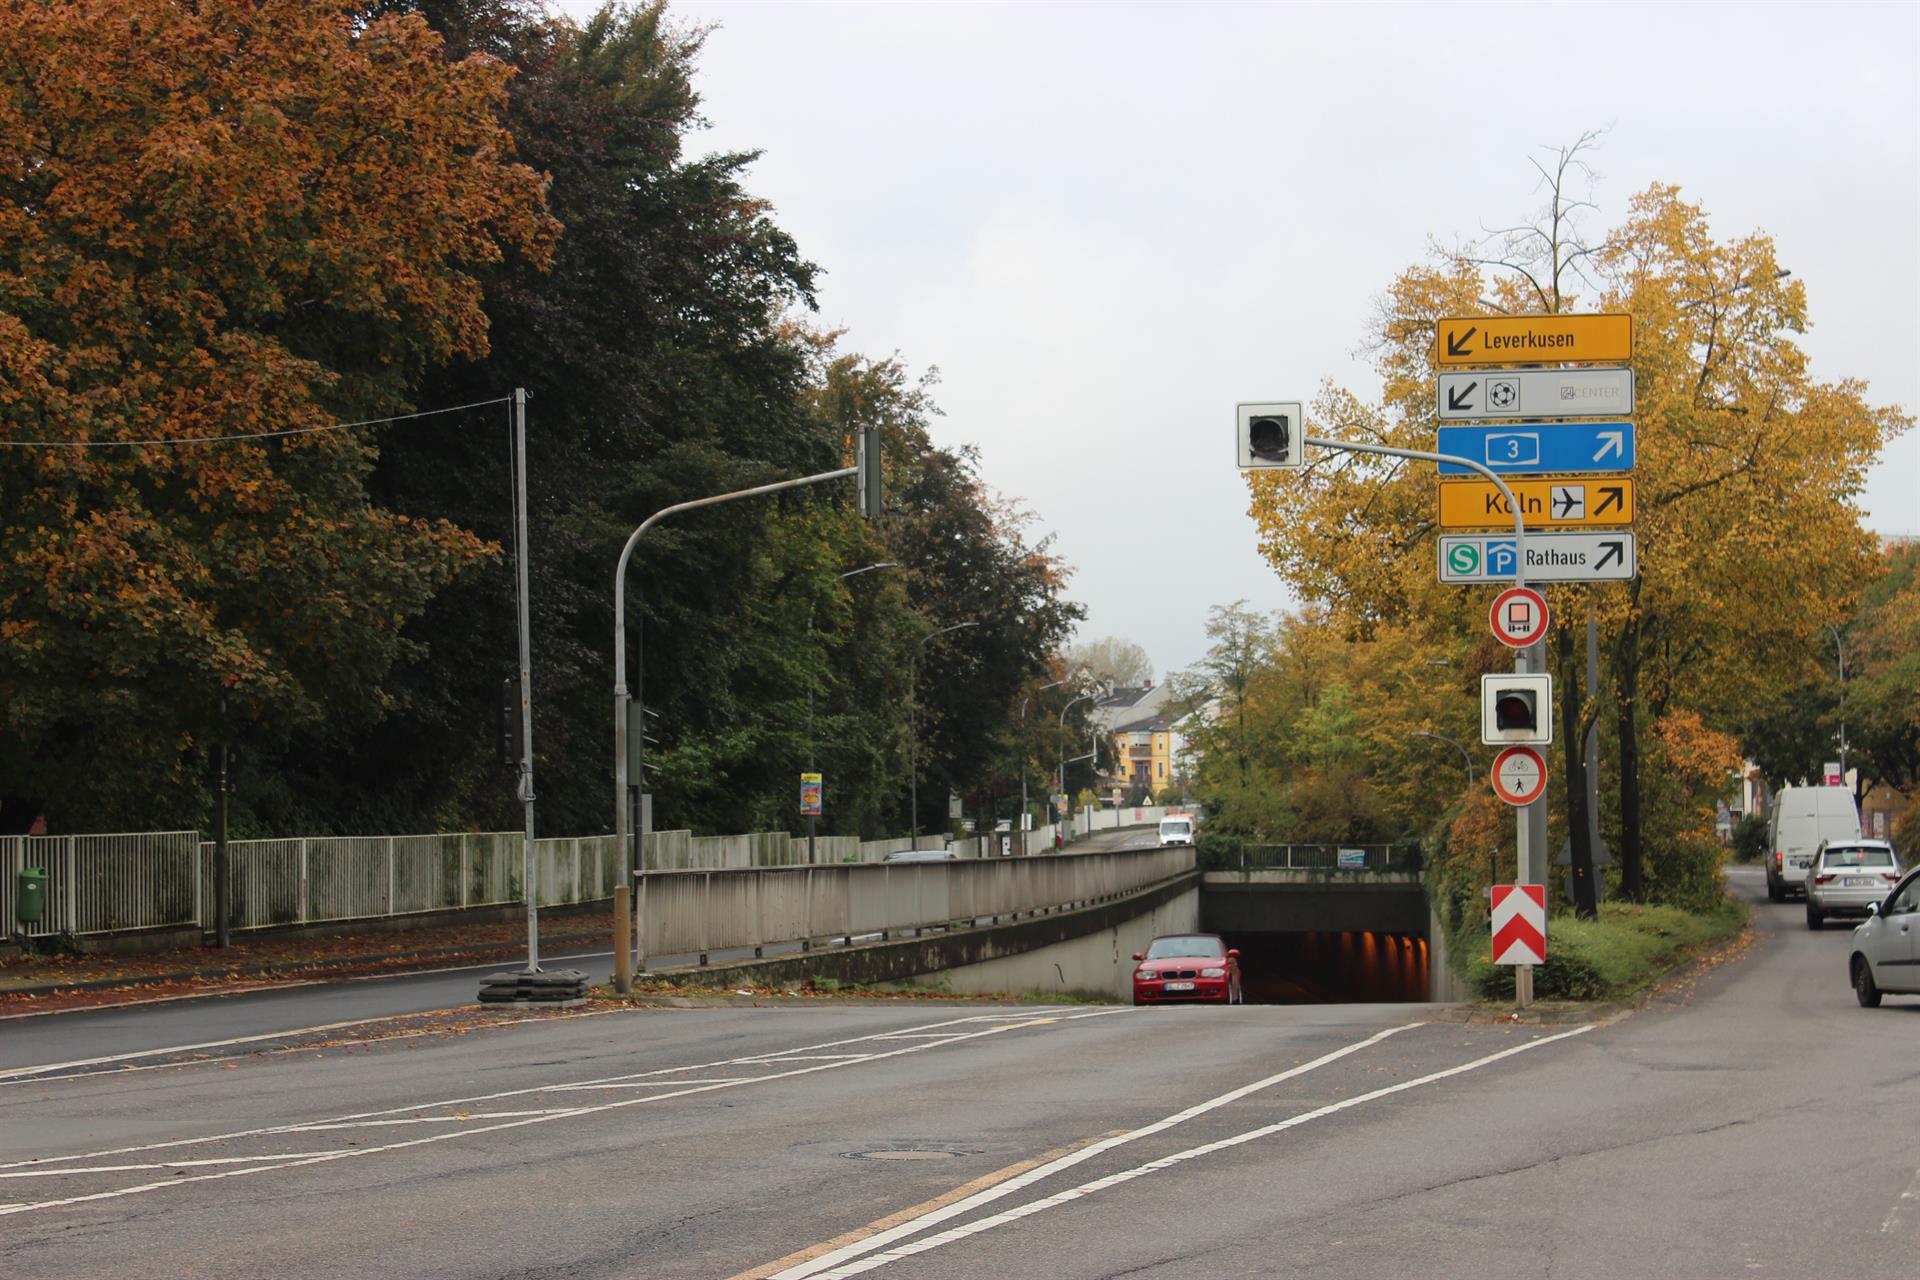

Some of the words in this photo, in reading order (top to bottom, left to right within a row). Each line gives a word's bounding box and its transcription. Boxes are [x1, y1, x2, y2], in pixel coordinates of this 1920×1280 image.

[1484, 330, 1574, 349] Leverkusen
[1507, 439, 1519, 459] 3
[1453, 547, 1474, 571] S
[1496, 551, 1512, 573] P
[1526, 549, 1586, 566] Rathaus
